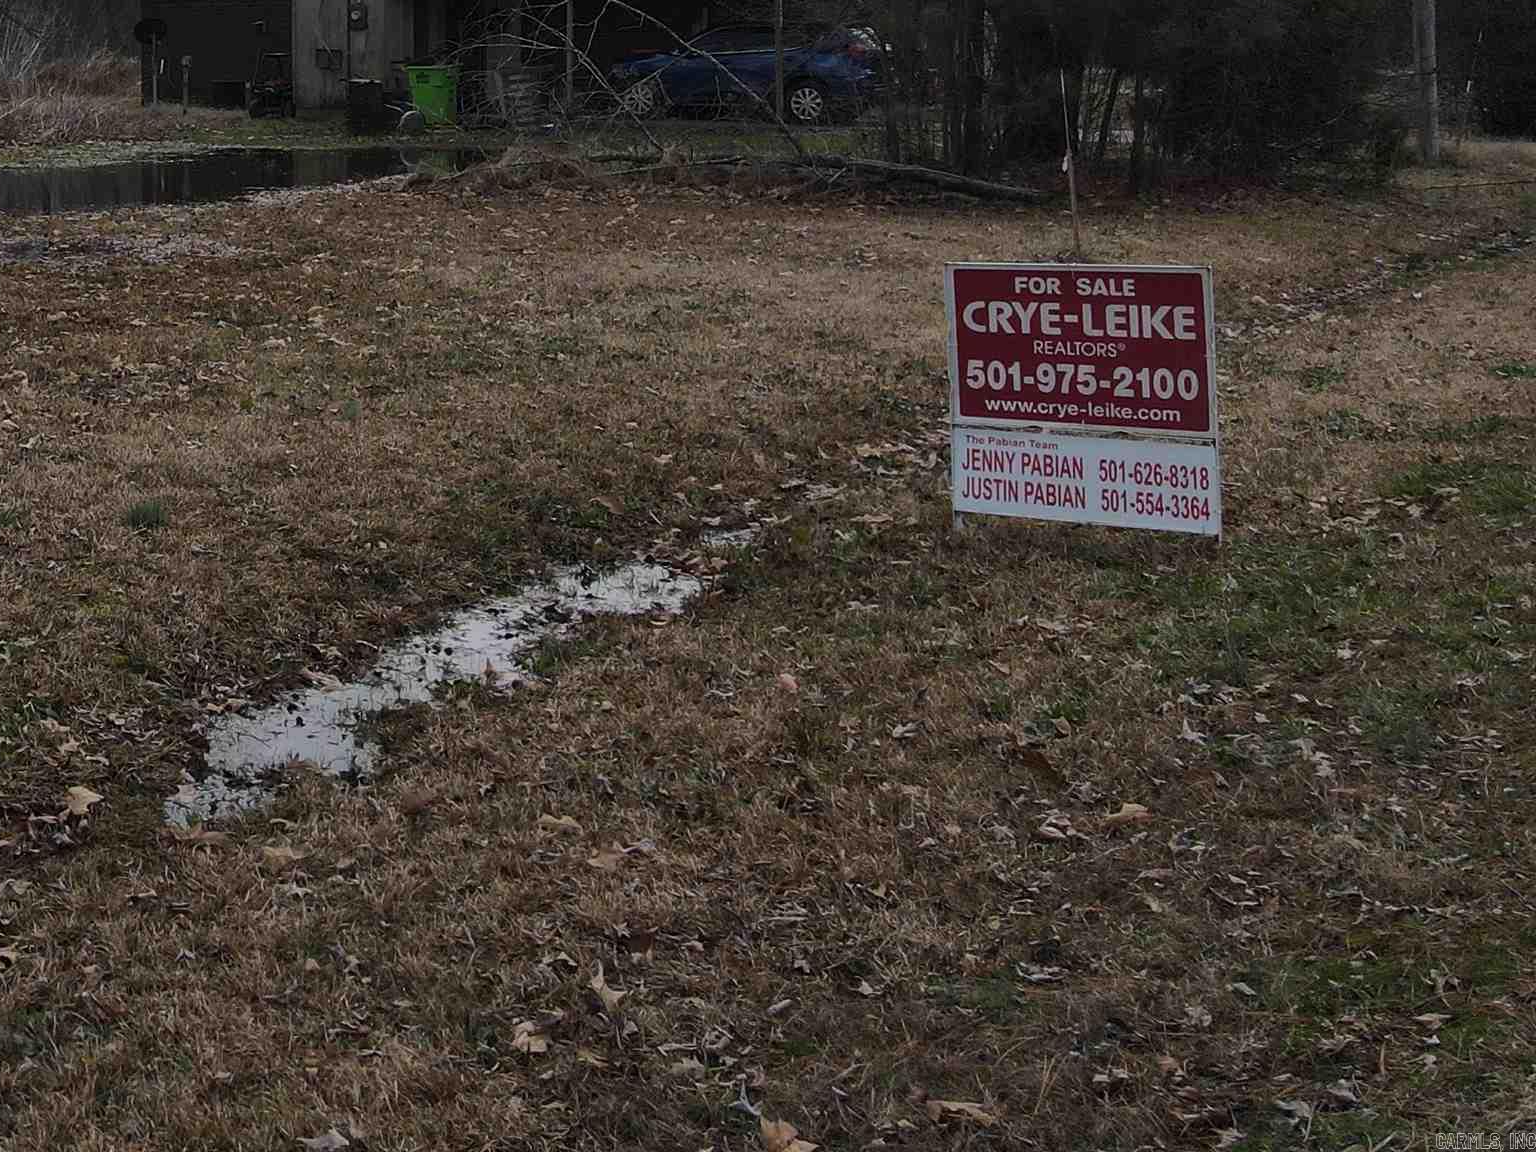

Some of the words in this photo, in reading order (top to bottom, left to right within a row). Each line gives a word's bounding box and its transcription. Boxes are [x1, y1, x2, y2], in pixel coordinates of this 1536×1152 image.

[1014, 276, 1062, 295] FOR
[1076, 278, 1136, 297] SALE
[962, 301, 1197, 340] CRYE-LEIKE
[966, 359, 1200, 401] 501-975-2100
[984, 399, 1182, 423] www.crye-leike.com
[965, 435, 985, 446] The
[988, 436, 1026, 449] Pabian
[1029, 438, 1059, 450] Team
[961, 448, 1015, 473] JENNY
[1021, 452, 1084, 480] PABIAN
[1099, 459, 1210, 491] 501-626-8318
[961, 477, 1019, 503] JUSTIN
[1024, 480, 1087, 510] PABIAN
[1101, 489, 1211, 521] 501-554-3364
